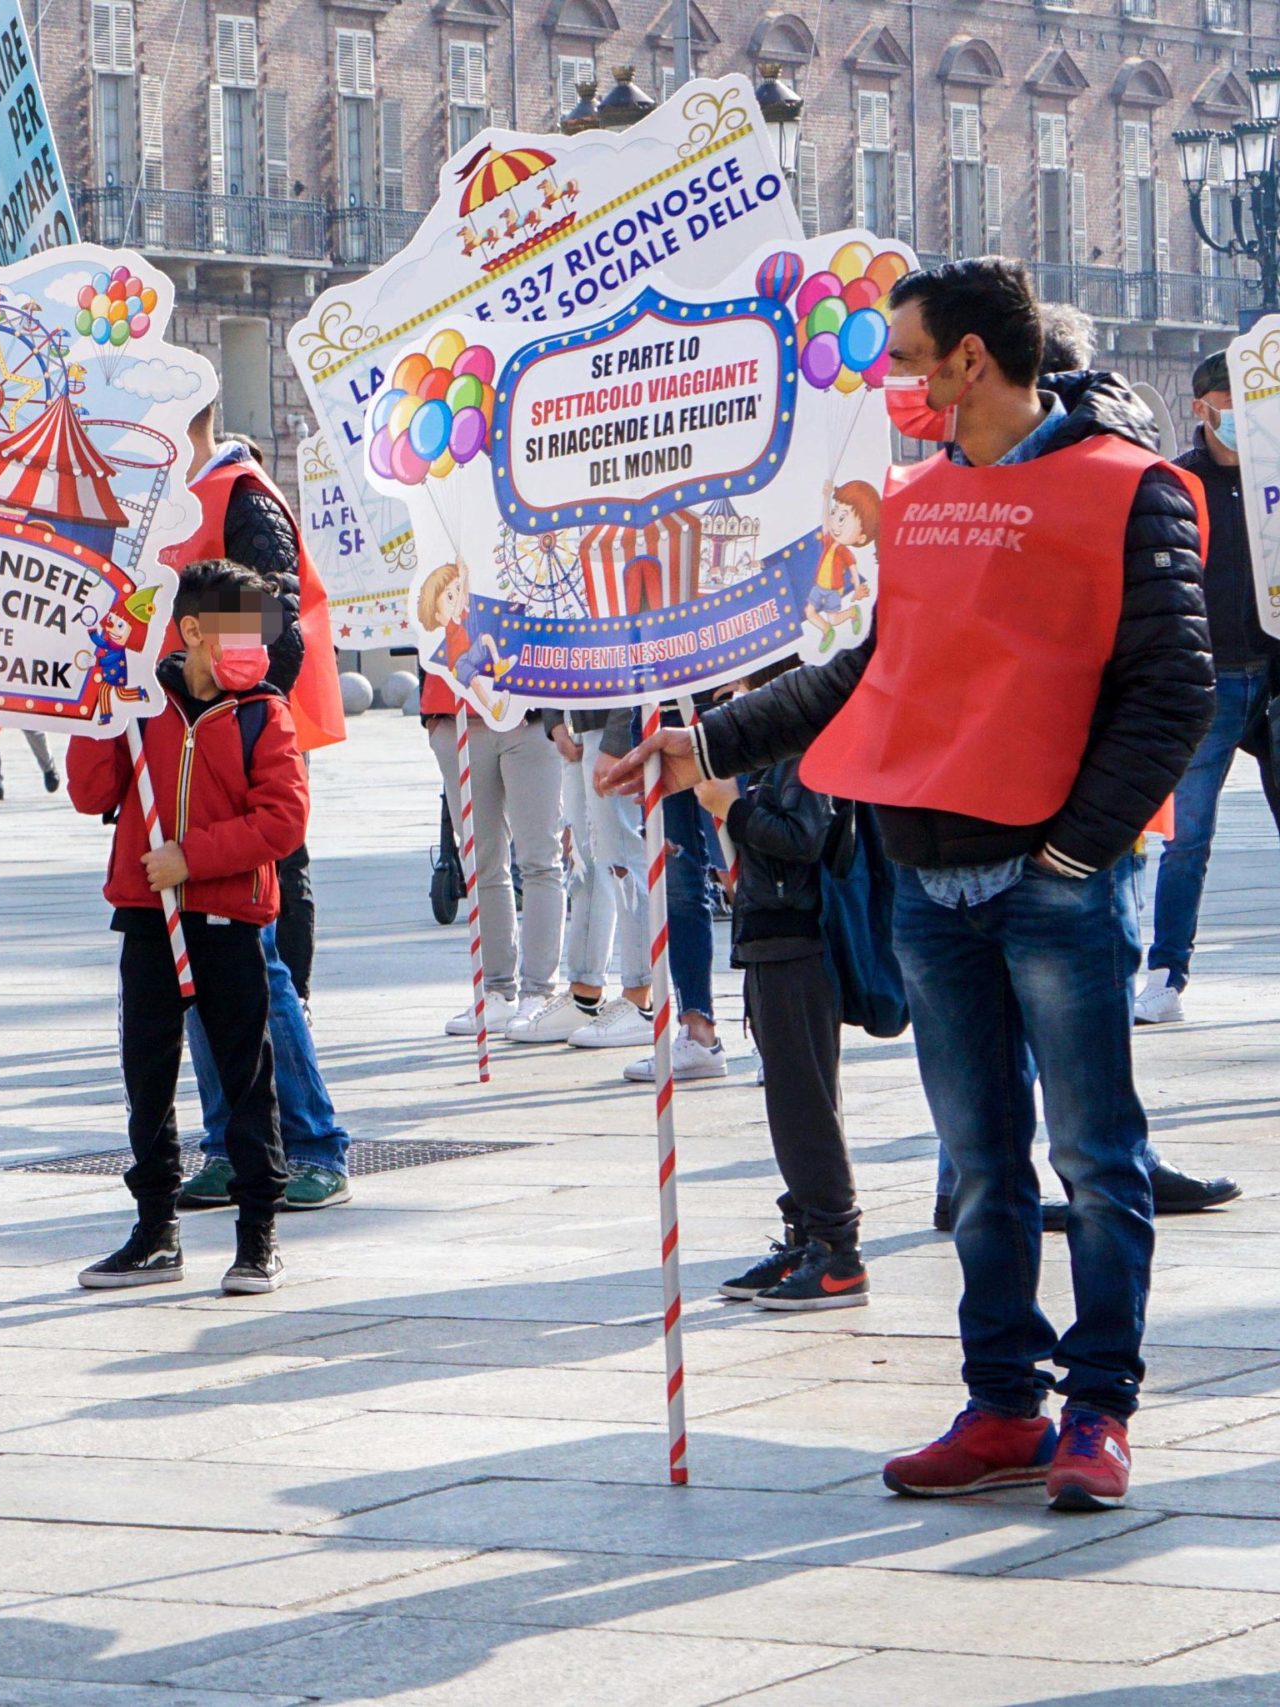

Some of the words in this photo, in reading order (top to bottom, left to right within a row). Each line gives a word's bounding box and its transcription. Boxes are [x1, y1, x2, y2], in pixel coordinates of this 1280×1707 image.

[8, 82, 44, 158] PER
[501, 263, 554, 315] 337
[564, 157, 744, 278] RICONOSCE
[557, 228, 681, 319] SOCIALE
[686, 174, 781, 242] DELLO
[591, 354, 612, 380] SE
[619, 340, 674, 375] PARTE
[679, 336, 700, 363] LO
[531, 381, 643, 427] SPETTACOLO
[648, 359, 759, 403] VIAGGIANTE
[525, 436, 544, 463] SI
[548, 415, 649, 459] RIACCENDE
[653, 411, 674, 438] LA
[680, 394, 762, 433] FELICITA'
[590, 460, 619, 487] DEL
[624, 443, 693, 481] MONDO
[311, 511, 334, 530] LA
[322, 485, 345, 506] LA
[902, 502, 1034, 526] RIAPRIAMO
[894, 527, 904, 546] I
[906, 527, 960, 546] LUNA
[965, 527, 1027, 553] PARK
[520, 644, 532, 667] A
[534, 644, 568, 669] LUCI
[571, 645, 626, 670] SPENTE
[629, 630, 697, 667] NESSUNO
[699, 626, 716, 651] SI
[718, 598, 781, 642] DIVERTE
